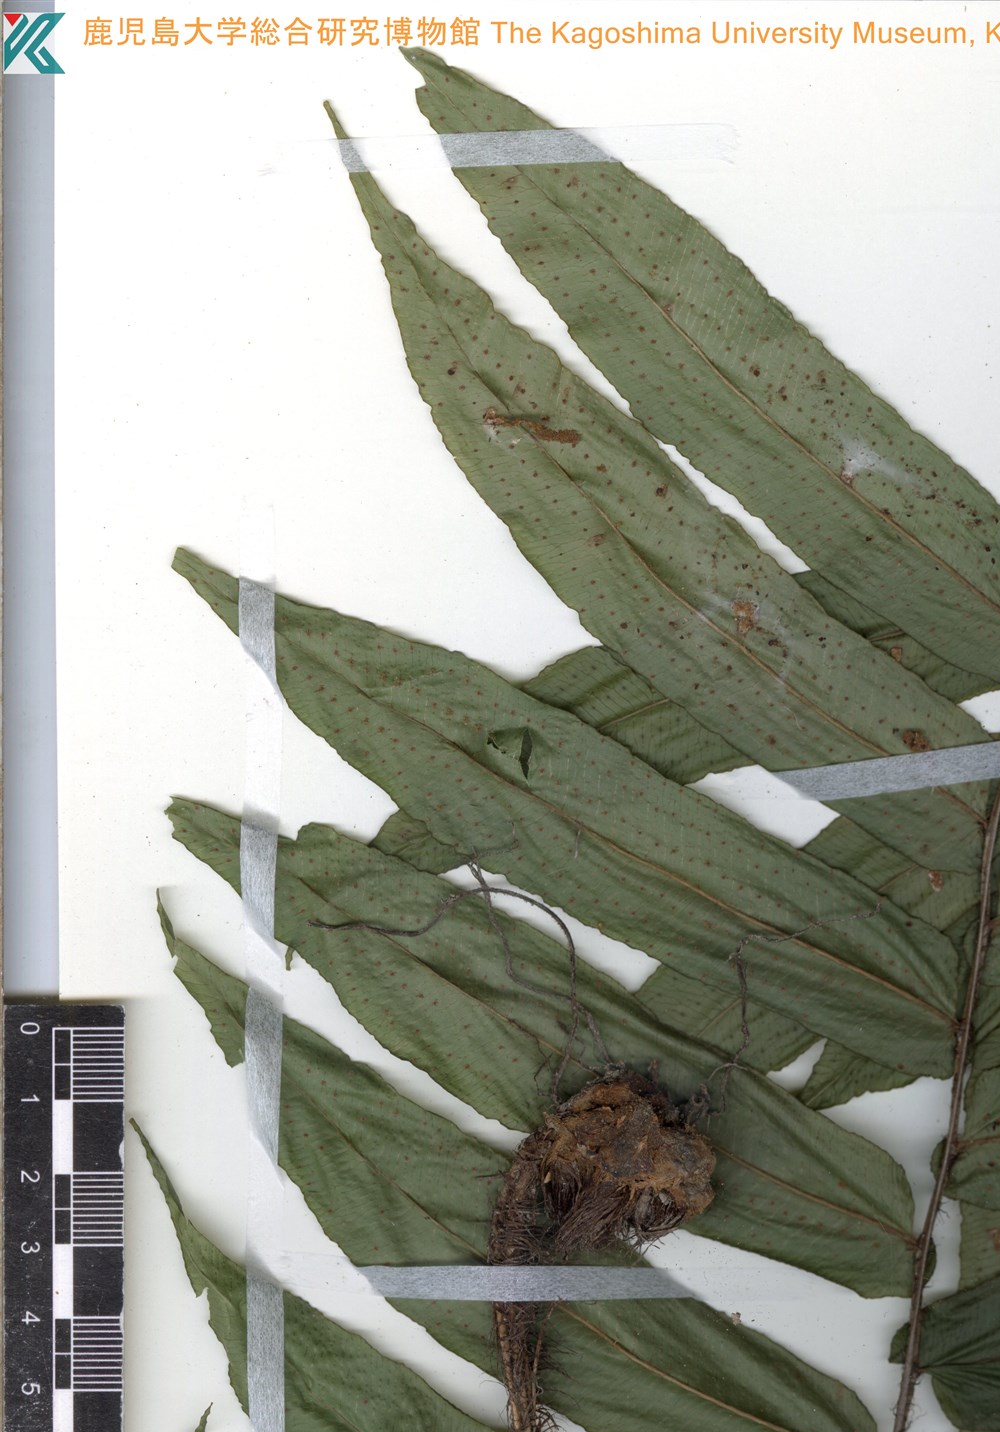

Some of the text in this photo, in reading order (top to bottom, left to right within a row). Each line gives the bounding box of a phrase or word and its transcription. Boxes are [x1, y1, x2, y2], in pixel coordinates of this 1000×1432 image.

[20, 1022, 40, 1034] 0
[21, 1171, 40, 1182] 2
[21, 1242, 40, 1253] 3
[22, 1311, 40, 1324] 4
[22, 1383, 40, 1395] 5
